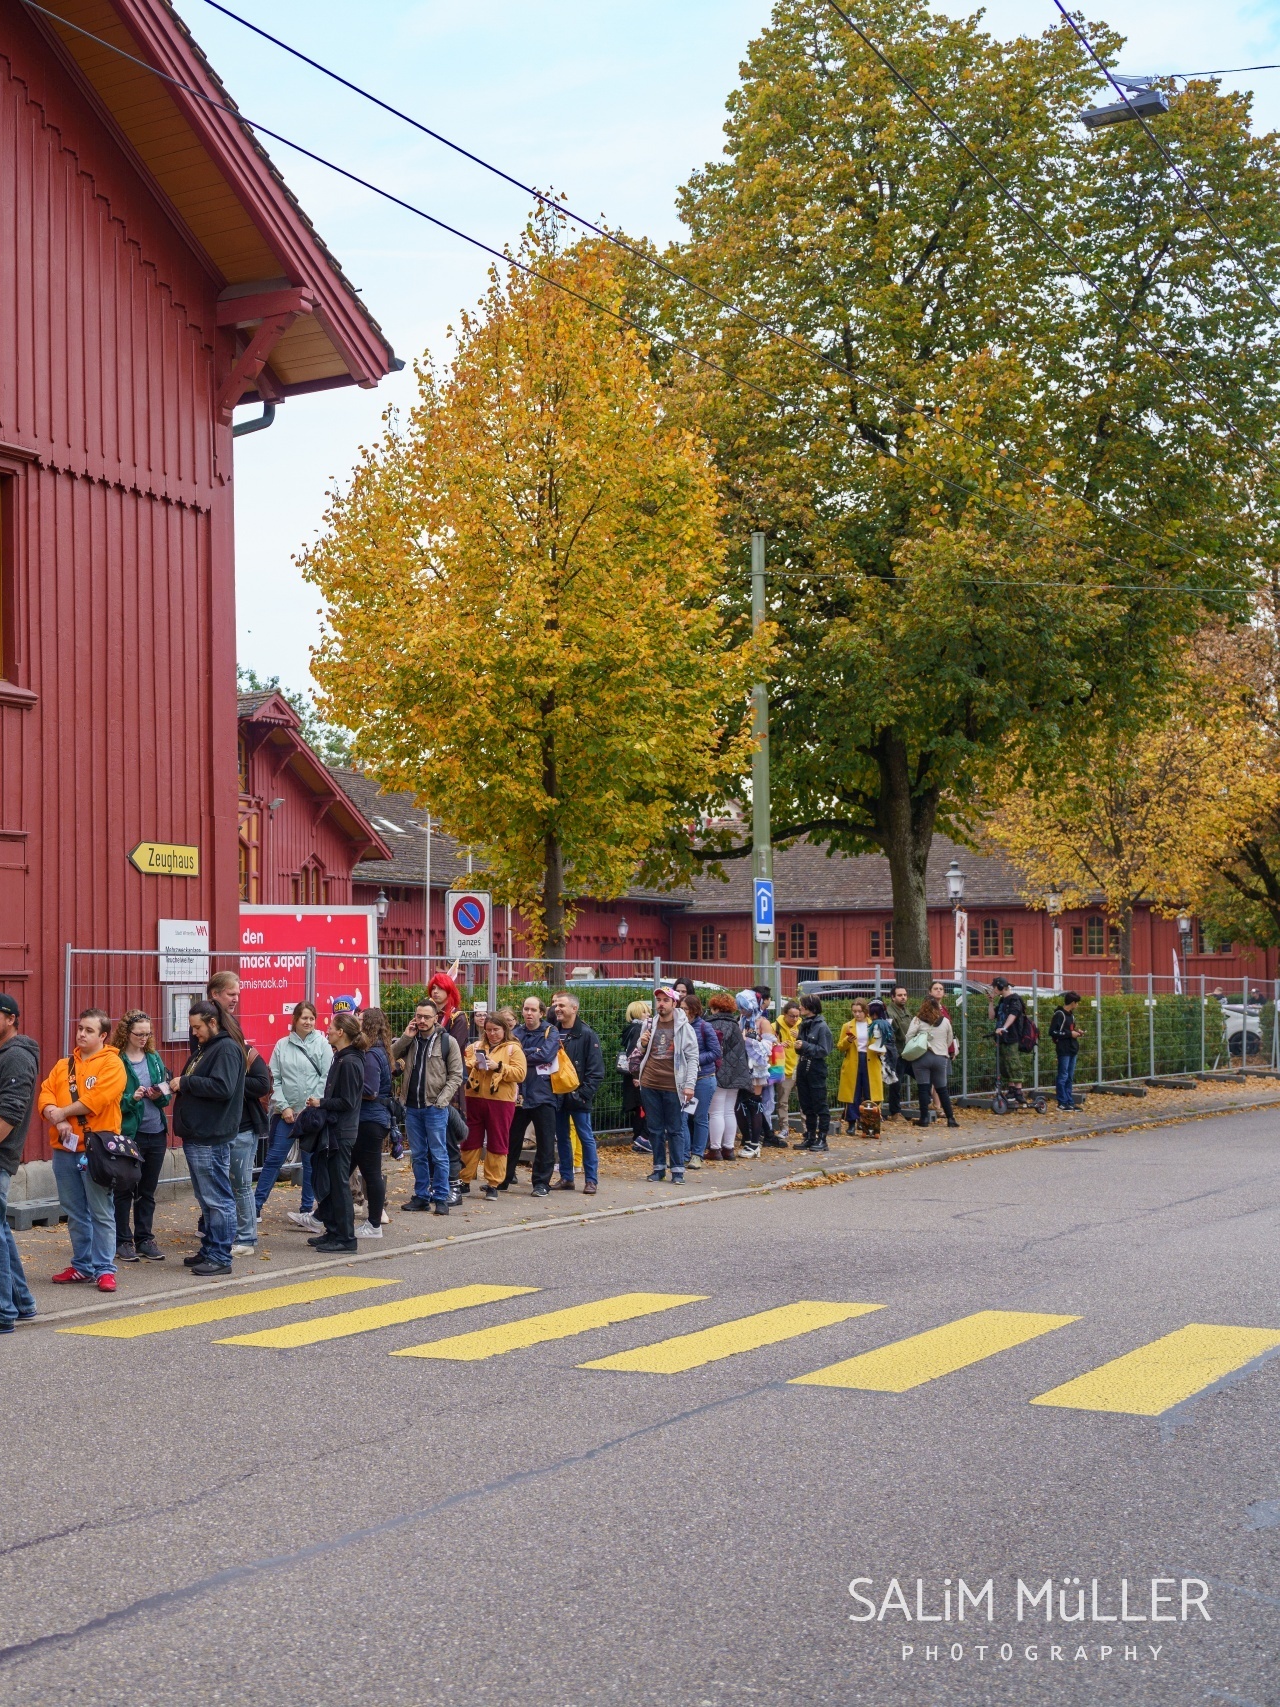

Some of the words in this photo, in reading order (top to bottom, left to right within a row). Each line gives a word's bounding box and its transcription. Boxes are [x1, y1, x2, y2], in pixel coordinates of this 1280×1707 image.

[148, 848, 194, 873] Zeughaus
[760, 896, 768, 920] P
[242, 927, 264, 945] den
[457, 939, 482, 948] ganzes
[239, 952, 272, 969] mack
[461, 949, 479, 959] Areal
[239, 977, 288, 990] amisnack.ch
